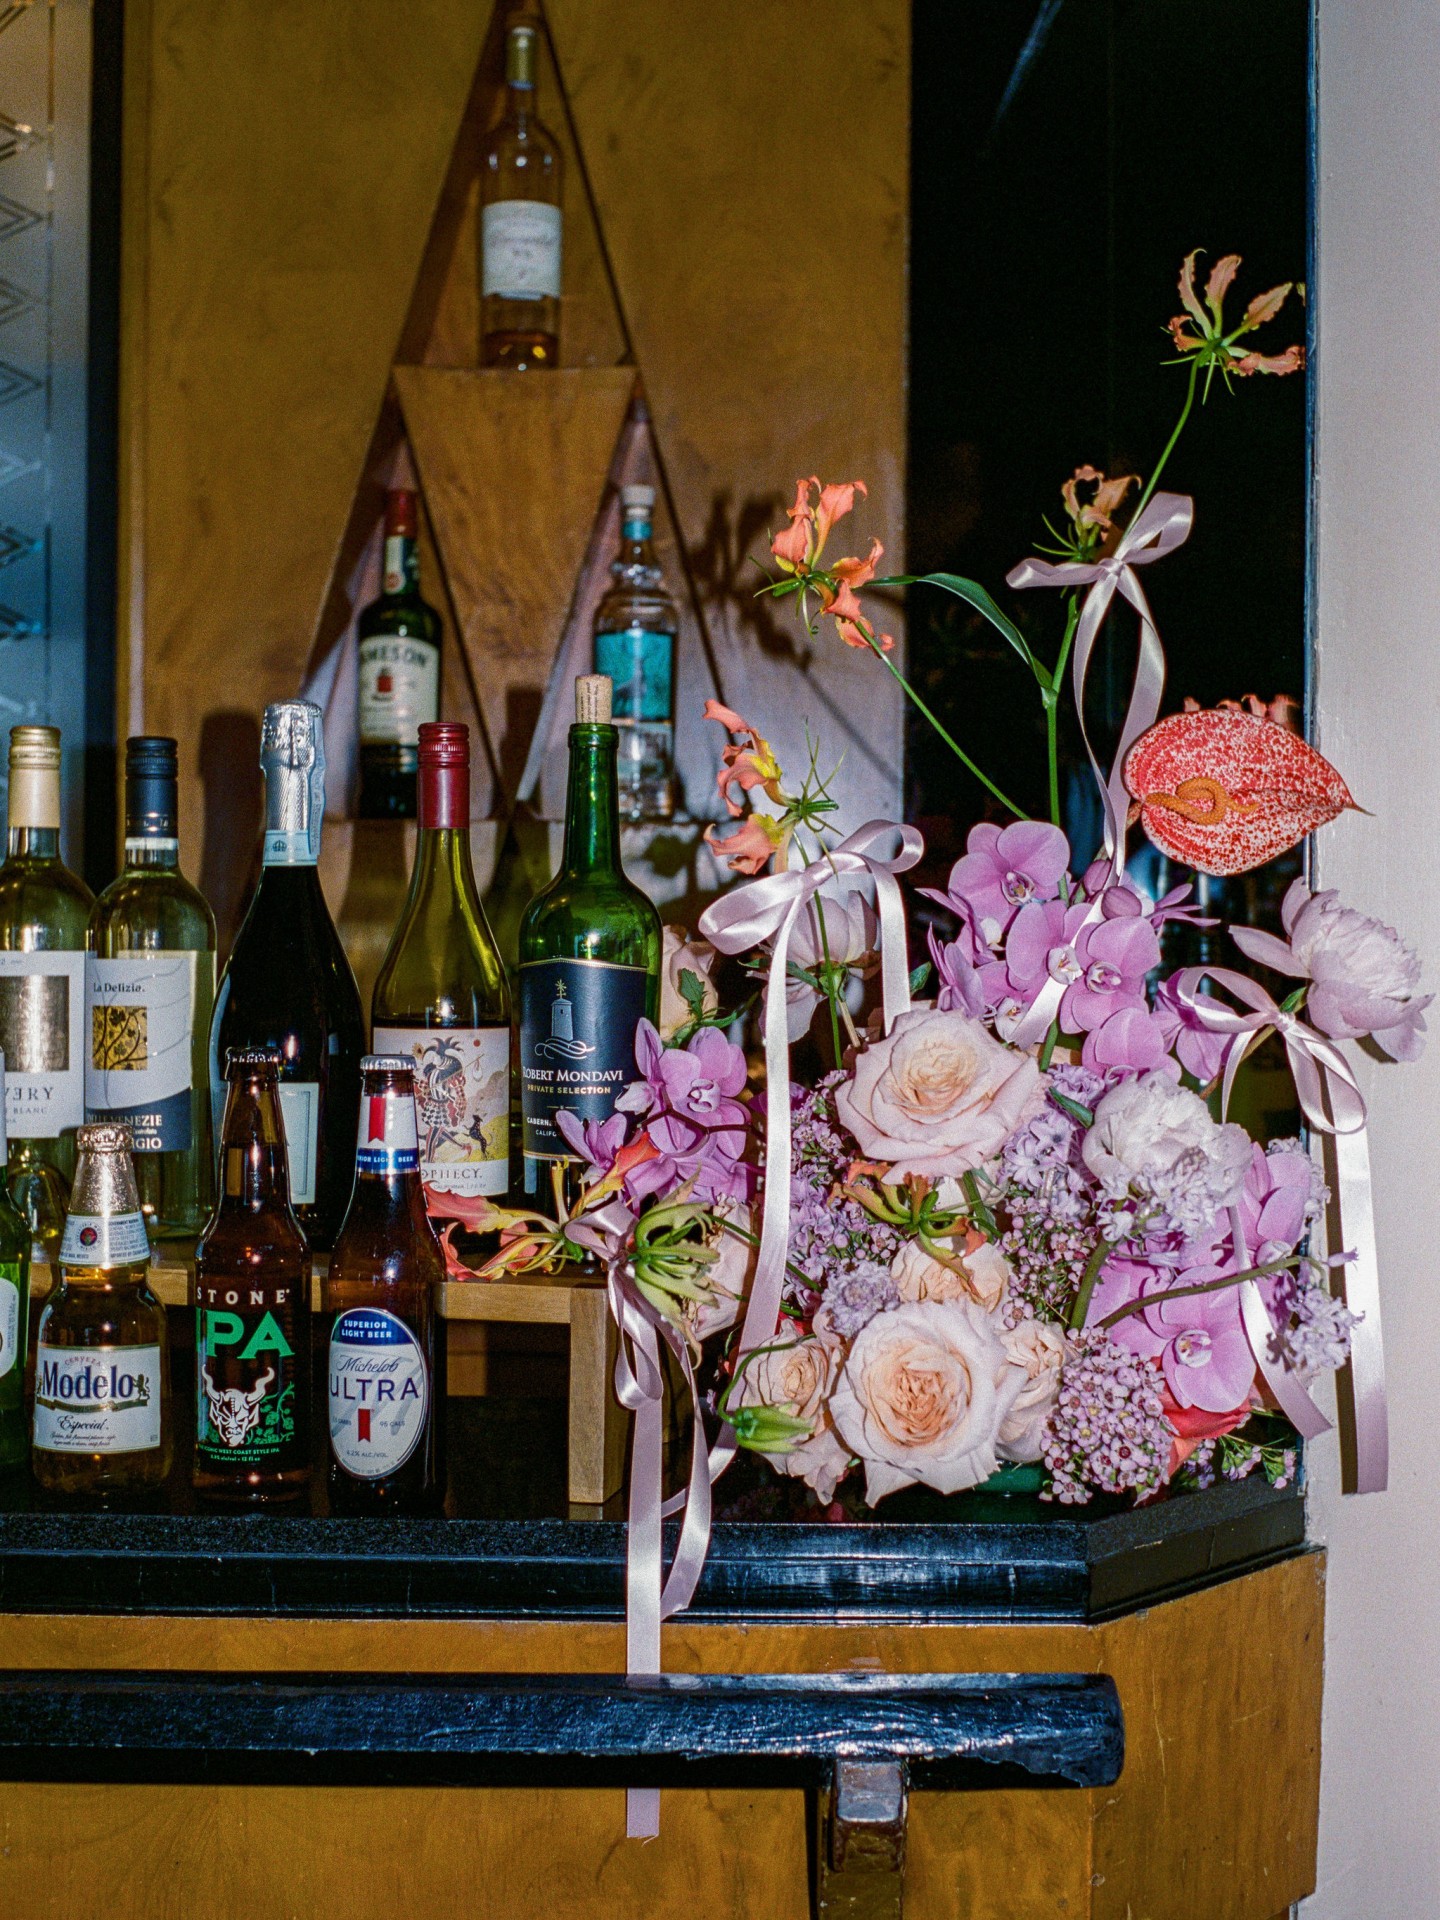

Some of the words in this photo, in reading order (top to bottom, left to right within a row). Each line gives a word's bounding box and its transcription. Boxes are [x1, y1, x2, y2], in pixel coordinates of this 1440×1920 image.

[522, 1066, 554, 1081] ROBERT
[555, 1069, 623, 1081] MONDAVI
[527, 1084, 554, 1094] PRIVATE
[557, 1086, 611, 1095] SELECTION
[526, 1117, 556, 1127] CABERN
[197, 1286, 286, 1305] STONE
[343, 1320, 388, 1329] SUPERIOR
[341, 1329, 364, 1338] LIGHT
[64, 1355, 102, 1367] CERVEZA
[336, 1354, 401, 1373] Michelob
[42, 1359, 134, 1400] Modelo
[329, 1373, 420, 1401] ULTRA
[57, 1413, 108, 1434] Especial
